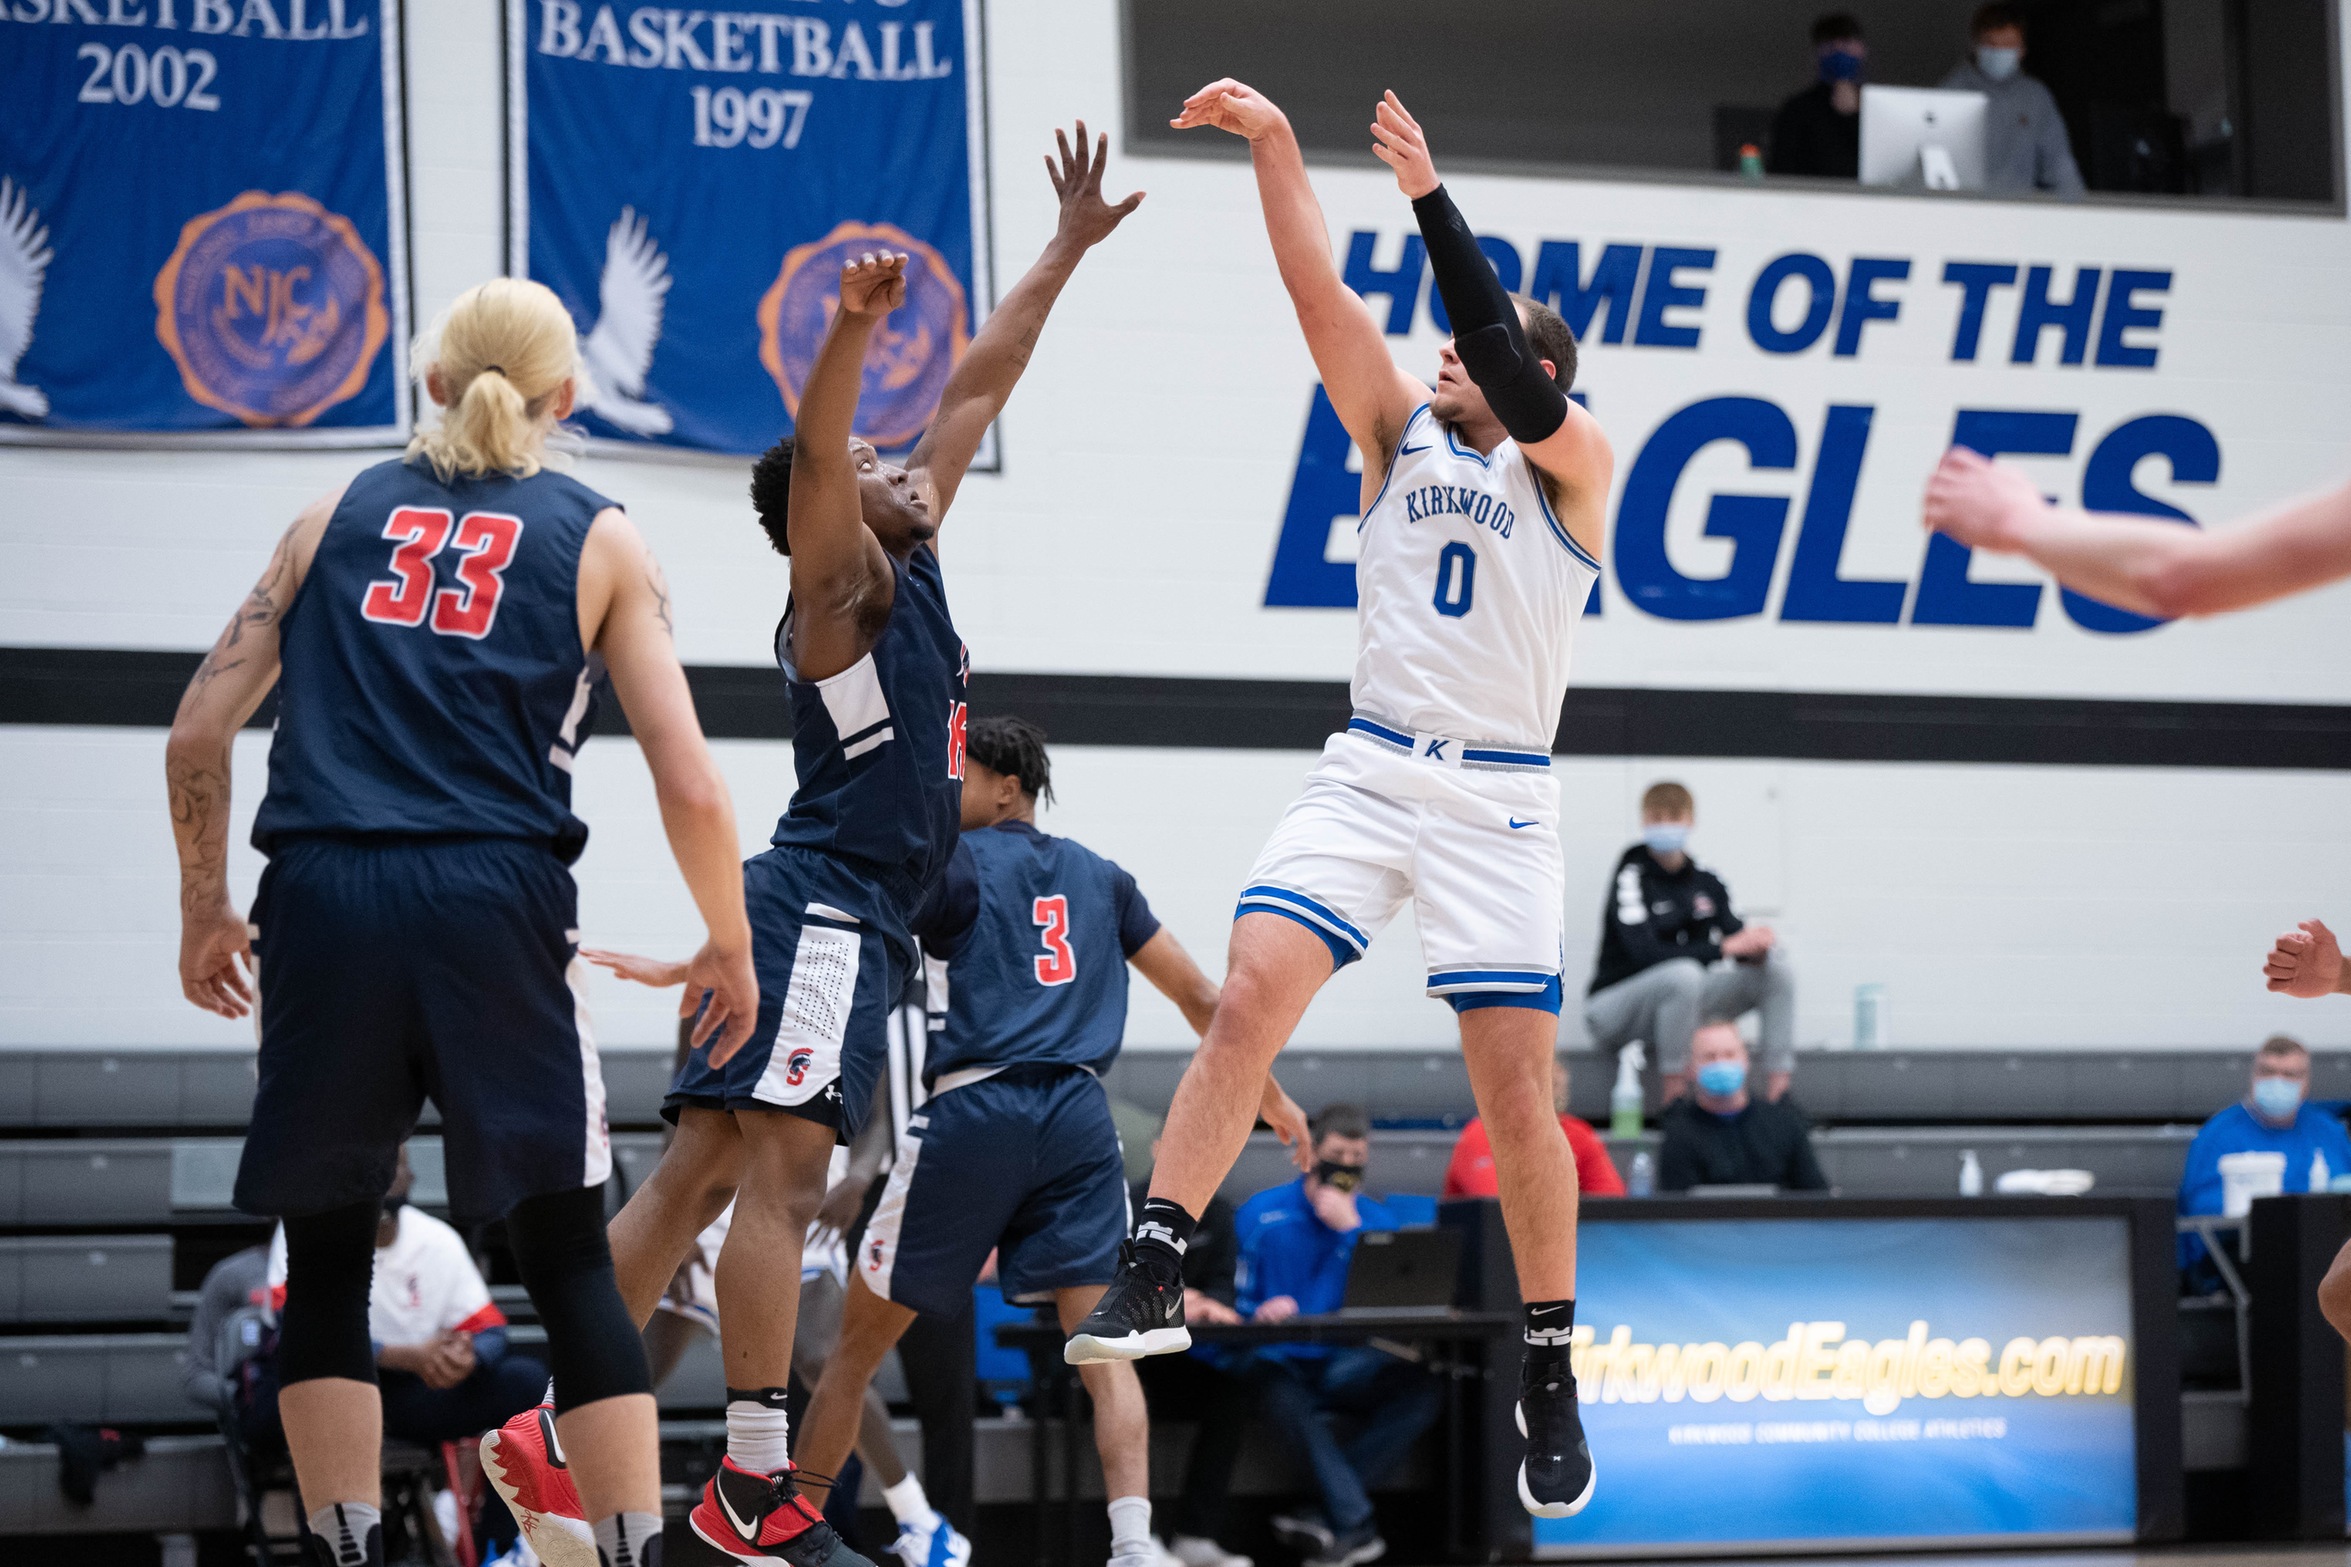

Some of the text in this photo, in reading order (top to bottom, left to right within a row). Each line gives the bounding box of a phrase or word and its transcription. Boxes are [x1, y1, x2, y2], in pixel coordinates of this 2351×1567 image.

[77, 42, 221, 112] 2002
[537, 0, 953, 81] BASKETBALL
[690, 85, 813, 150] 1997
[1746, 253, 1911, 357] OF
[1942, 261, 2173, 368] THE
[1264, 383, 2220, 635] EGLES
[1405, 484, 1515, 540] KIRKWOOD
[361, 505, 524, 640] 33
[1432, 539, 1478, 620] 0
[1424, 739, 1450, 761] K
[1033, 894, 1076, 986] 3
[1571, 1320, 2126, 1415] irkwoodEagles.com
